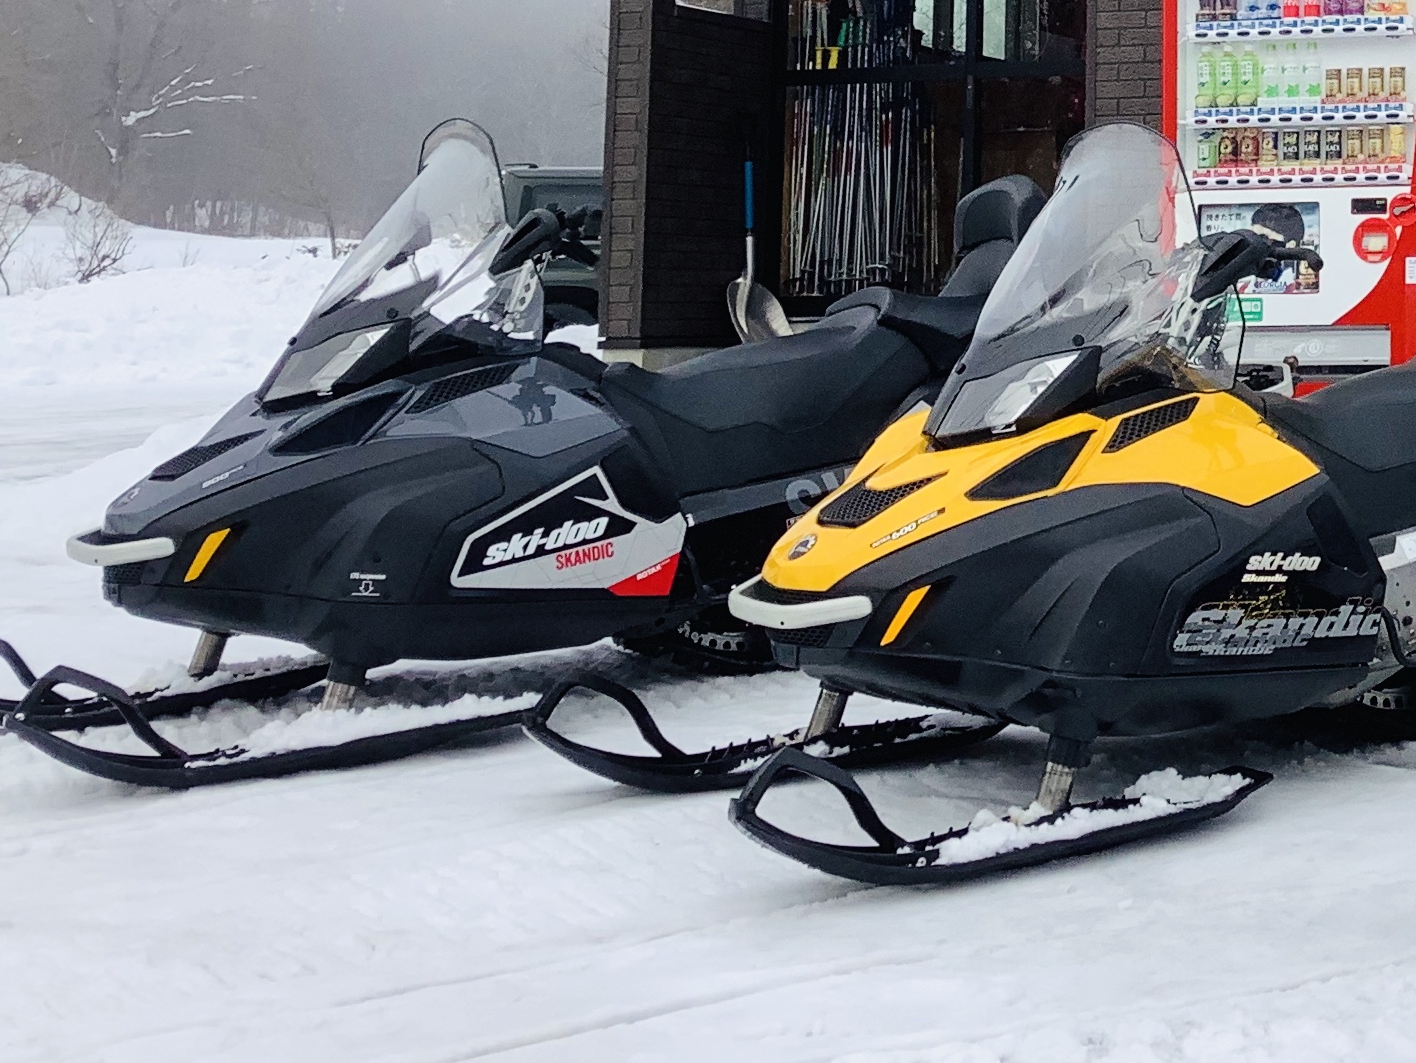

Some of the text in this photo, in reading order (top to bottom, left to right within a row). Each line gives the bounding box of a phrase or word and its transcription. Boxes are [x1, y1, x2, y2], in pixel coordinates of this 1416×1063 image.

[891, 522, 917, 540] 600
[482, 517, 609, 566] ski-doo
[556, 542, 615, 570] SKANDIC
[1246, 551, 1321, 571] ski-doo
[1241, 573, 1289, 583] Skandic
